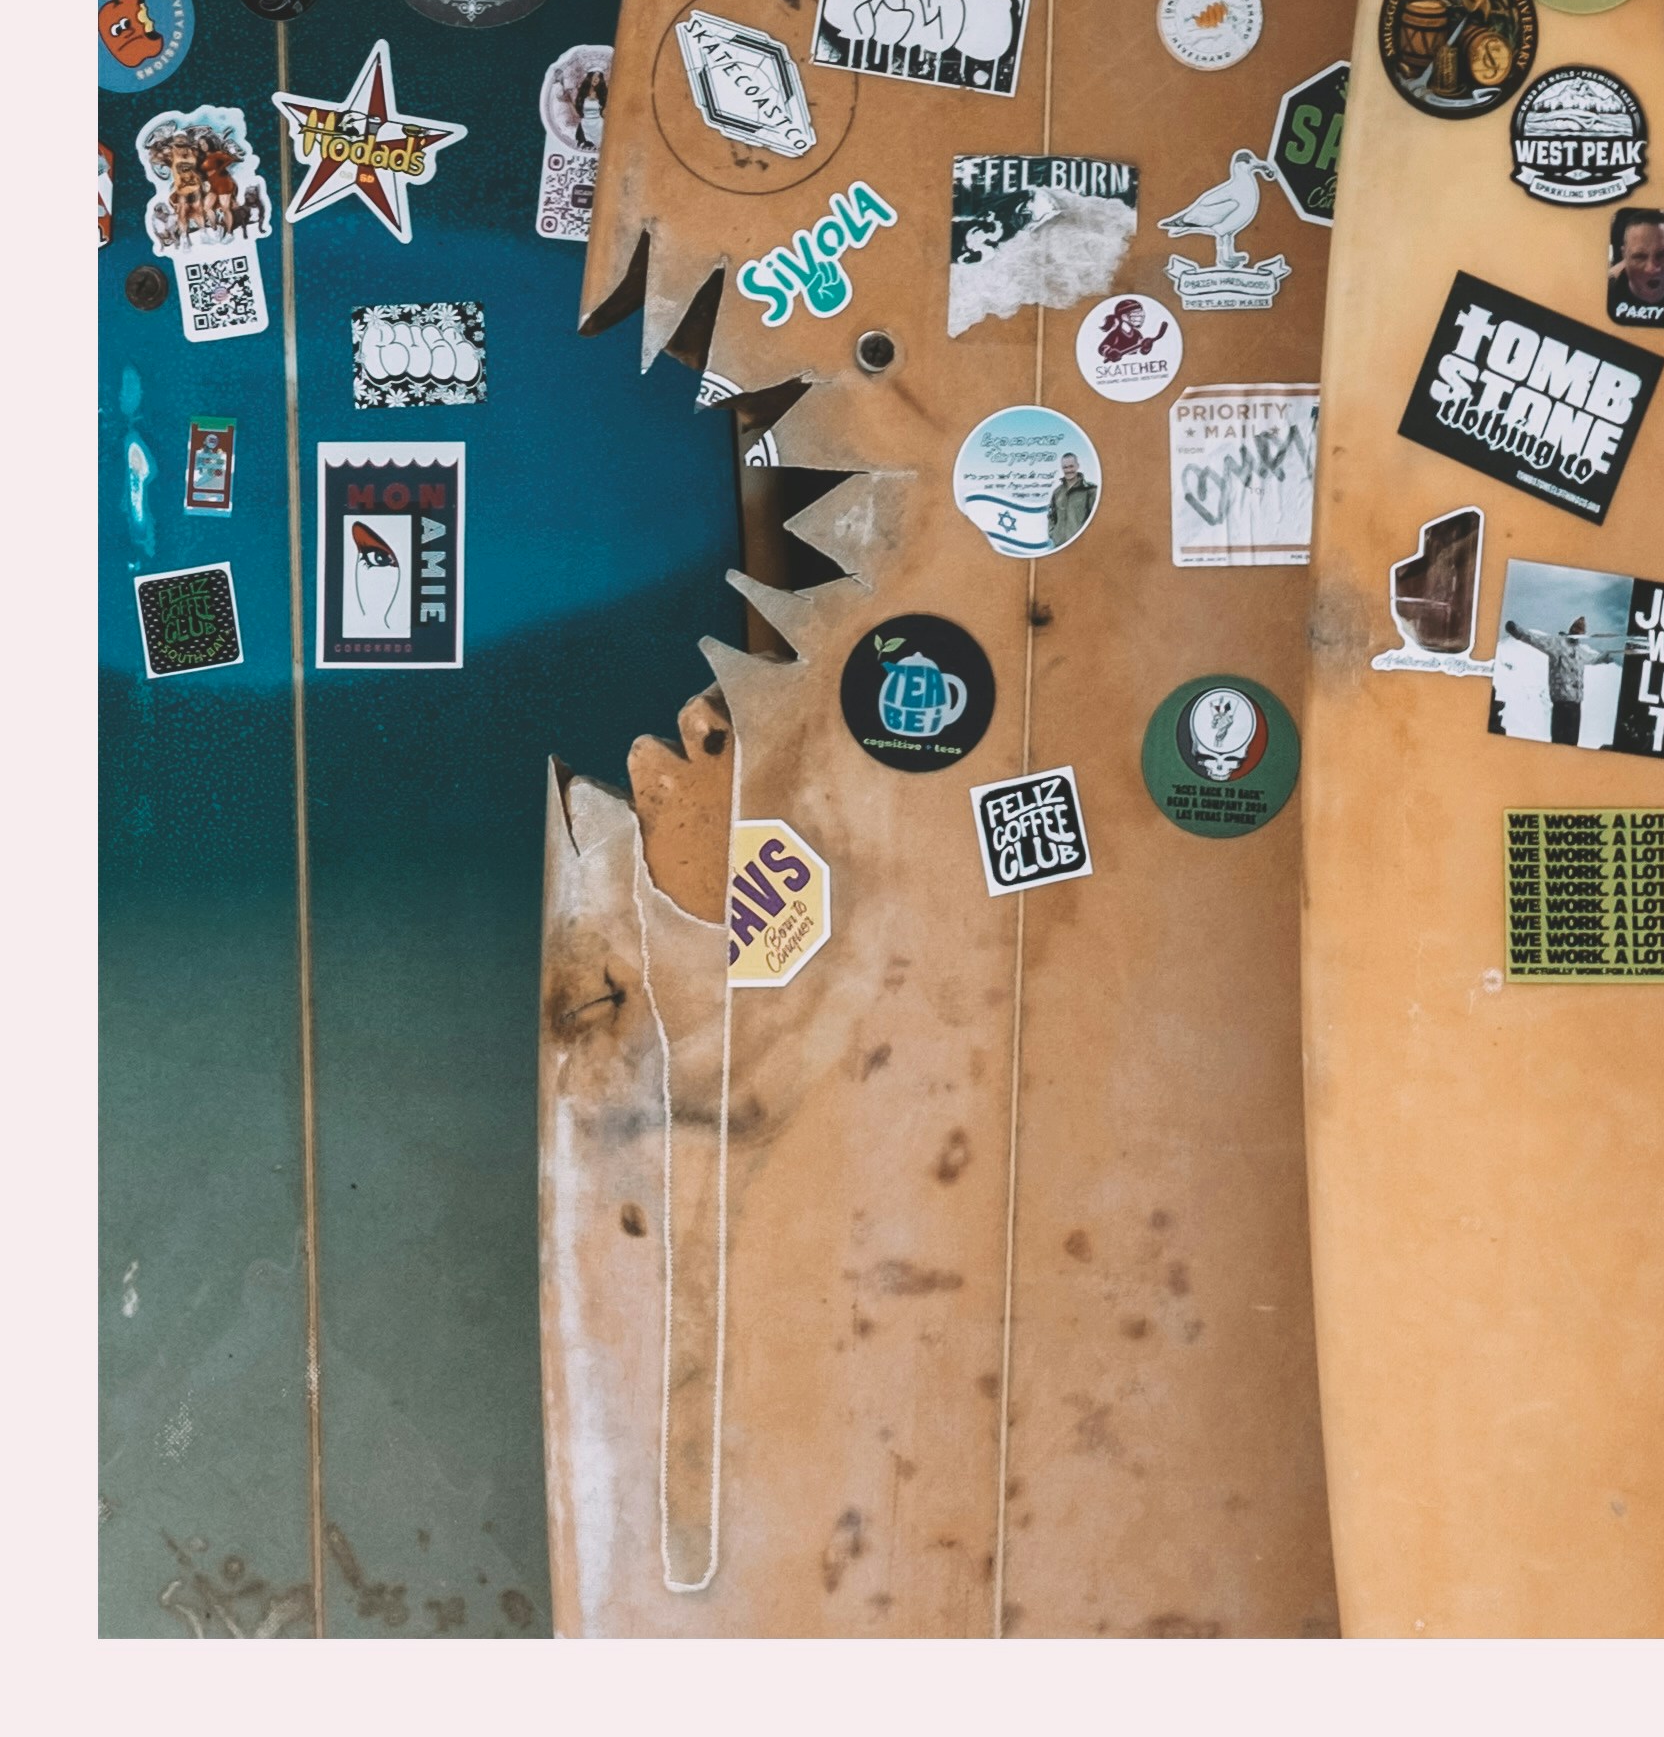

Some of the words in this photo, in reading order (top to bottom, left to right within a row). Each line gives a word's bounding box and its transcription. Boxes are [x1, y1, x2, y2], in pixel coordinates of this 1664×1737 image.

[1515, 140, 1577, 166] WEST
[1582, 140, 1641, 166] PEAK
[1535, 182, 1584, 199] SPARKLING
[1587, 182, 1623, 197] SPIRITS
[1430, 354, 1623, 474] STONE
[348, 484, 445, 509] MON
[420, 517, 445, 622] AMIE
